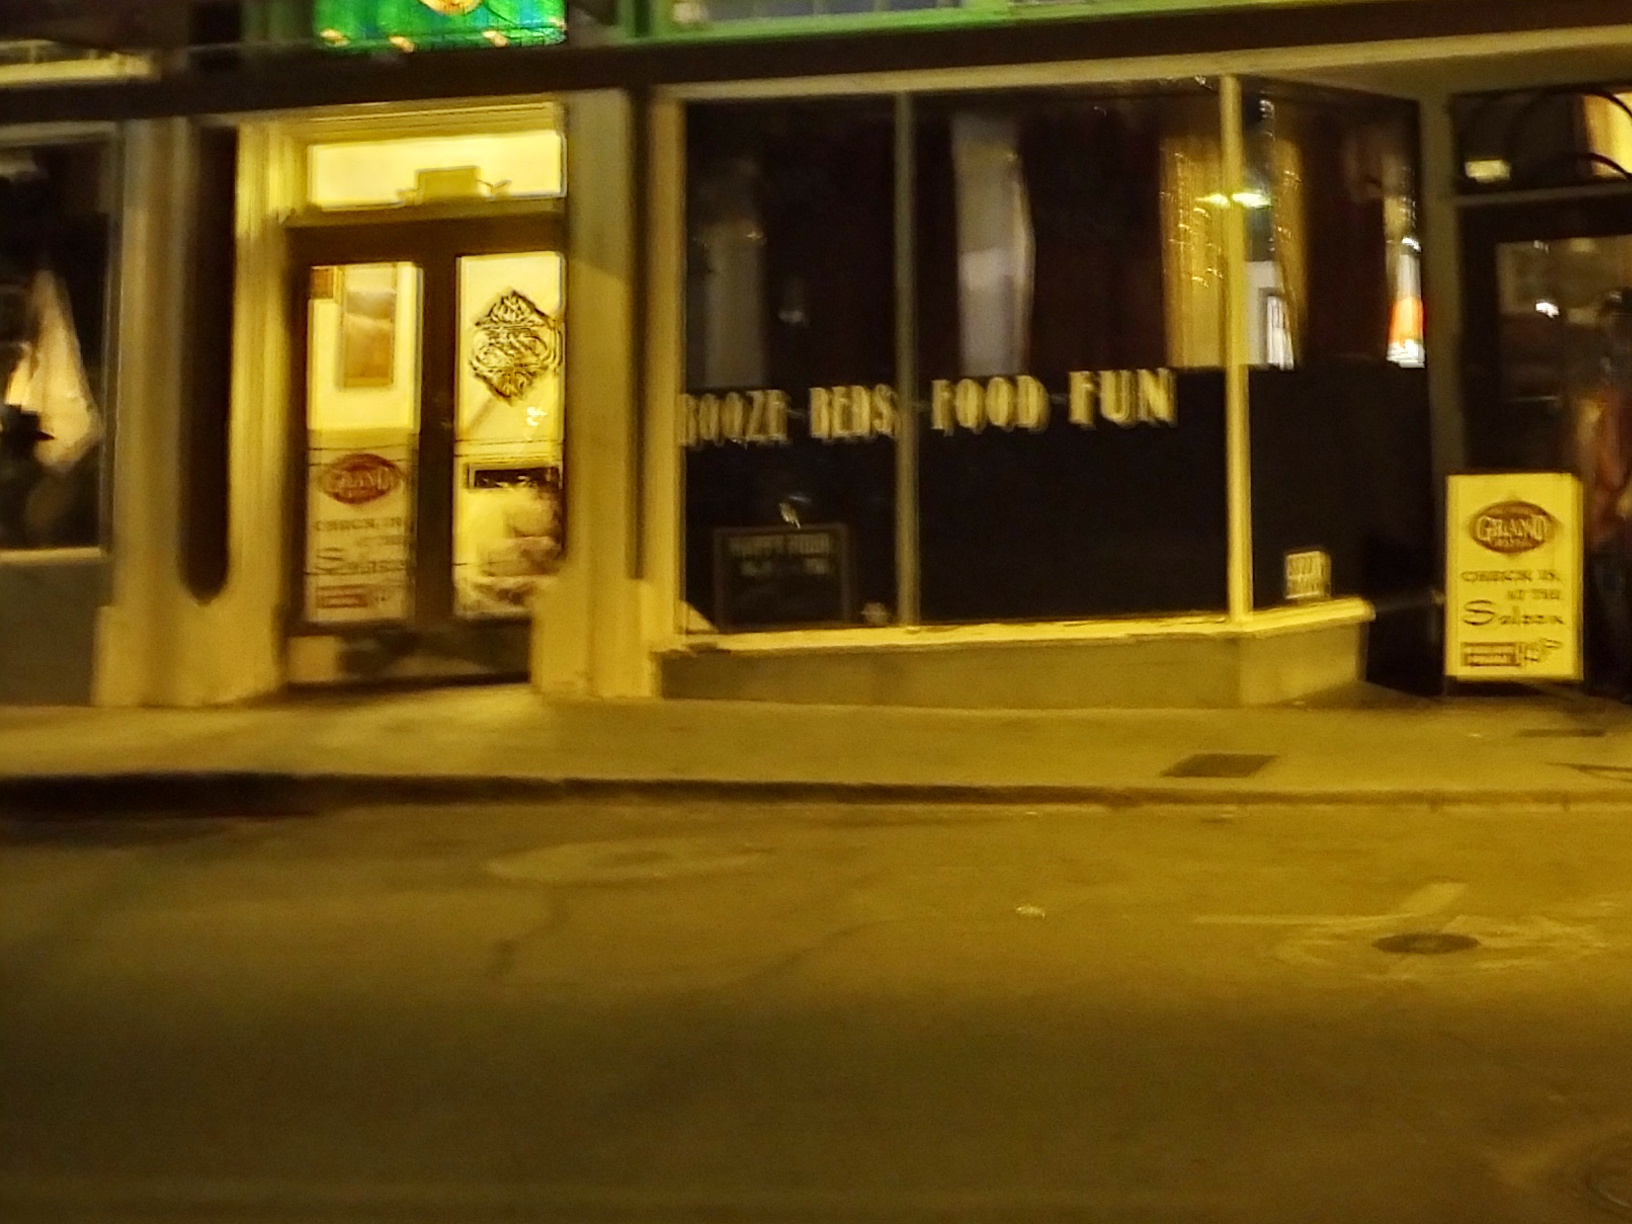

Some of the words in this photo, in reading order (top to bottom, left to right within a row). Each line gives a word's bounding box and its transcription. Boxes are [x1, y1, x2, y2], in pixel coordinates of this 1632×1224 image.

[680, 388, 791, 449] BOOZE
[809, 382, 905, 443] BEDS
[931, 374, 1052, 436] FOOD
[1069, 367, 1179, 431] FUN
[1476, 515, 1549, 542] GRAND
